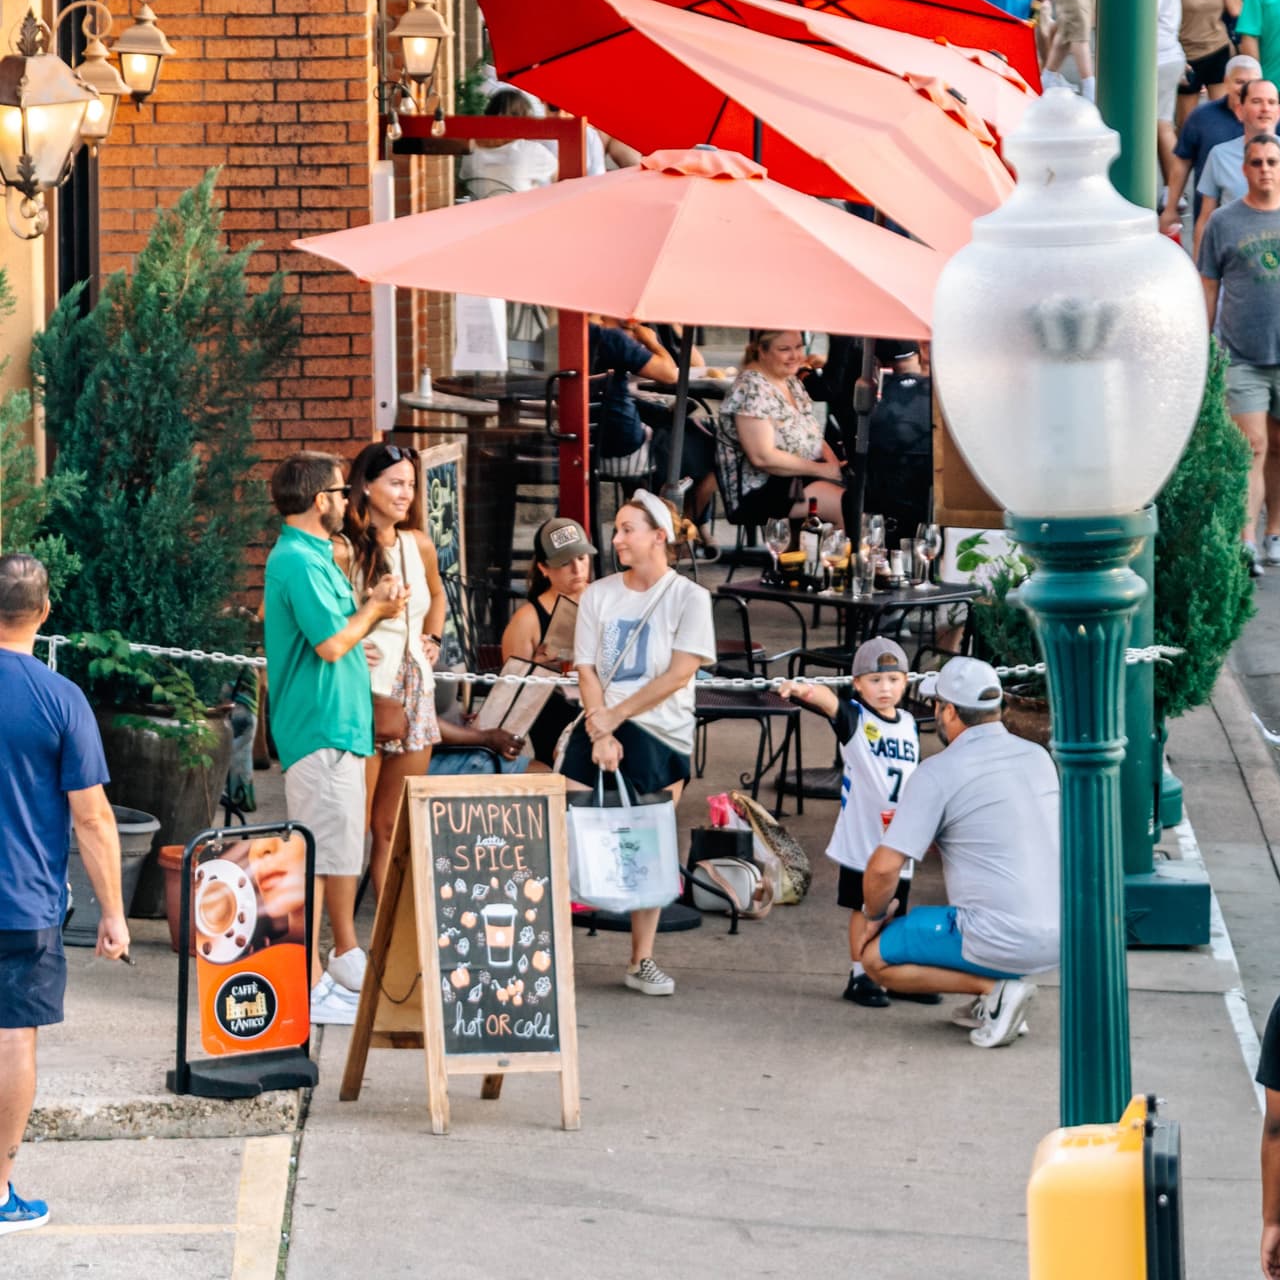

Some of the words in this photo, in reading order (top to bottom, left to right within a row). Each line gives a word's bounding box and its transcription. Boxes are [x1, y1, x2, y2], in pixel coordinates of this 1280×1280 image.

[887, 766, 903, 804] 7
[432, 800, 543, 840] PUMPKIN
[453, 845, 529, 871] SPICE
[452, 1000, 484, 1039] hot
[485, 1013, 512, 1036] OR
[513, 1011, 555, 1039] cold
